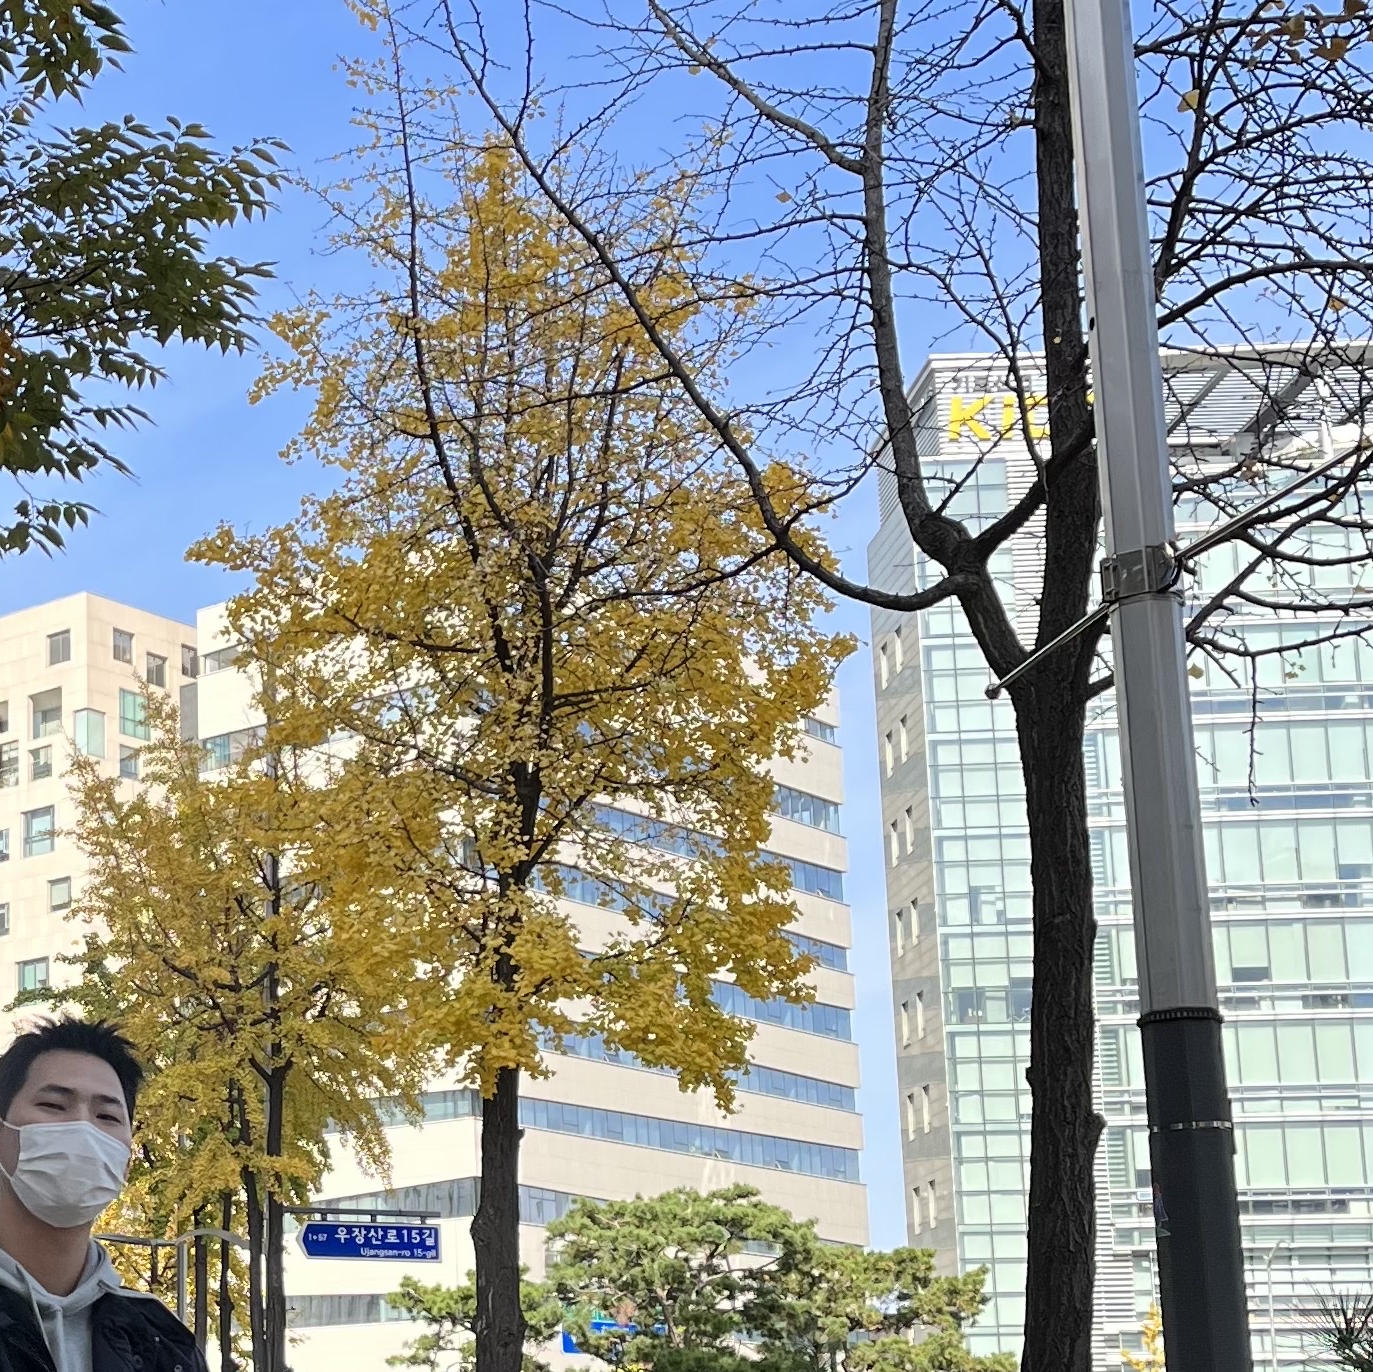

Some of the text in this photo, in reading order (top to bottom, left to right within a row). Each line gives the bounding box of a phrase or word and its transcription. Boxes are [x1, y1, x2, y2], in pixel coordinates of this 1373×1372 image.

[334, 1226, 436, 1246] 우장산로15길
[360, 1247, 437, 1259] Ujangsan-ro 15-gil
